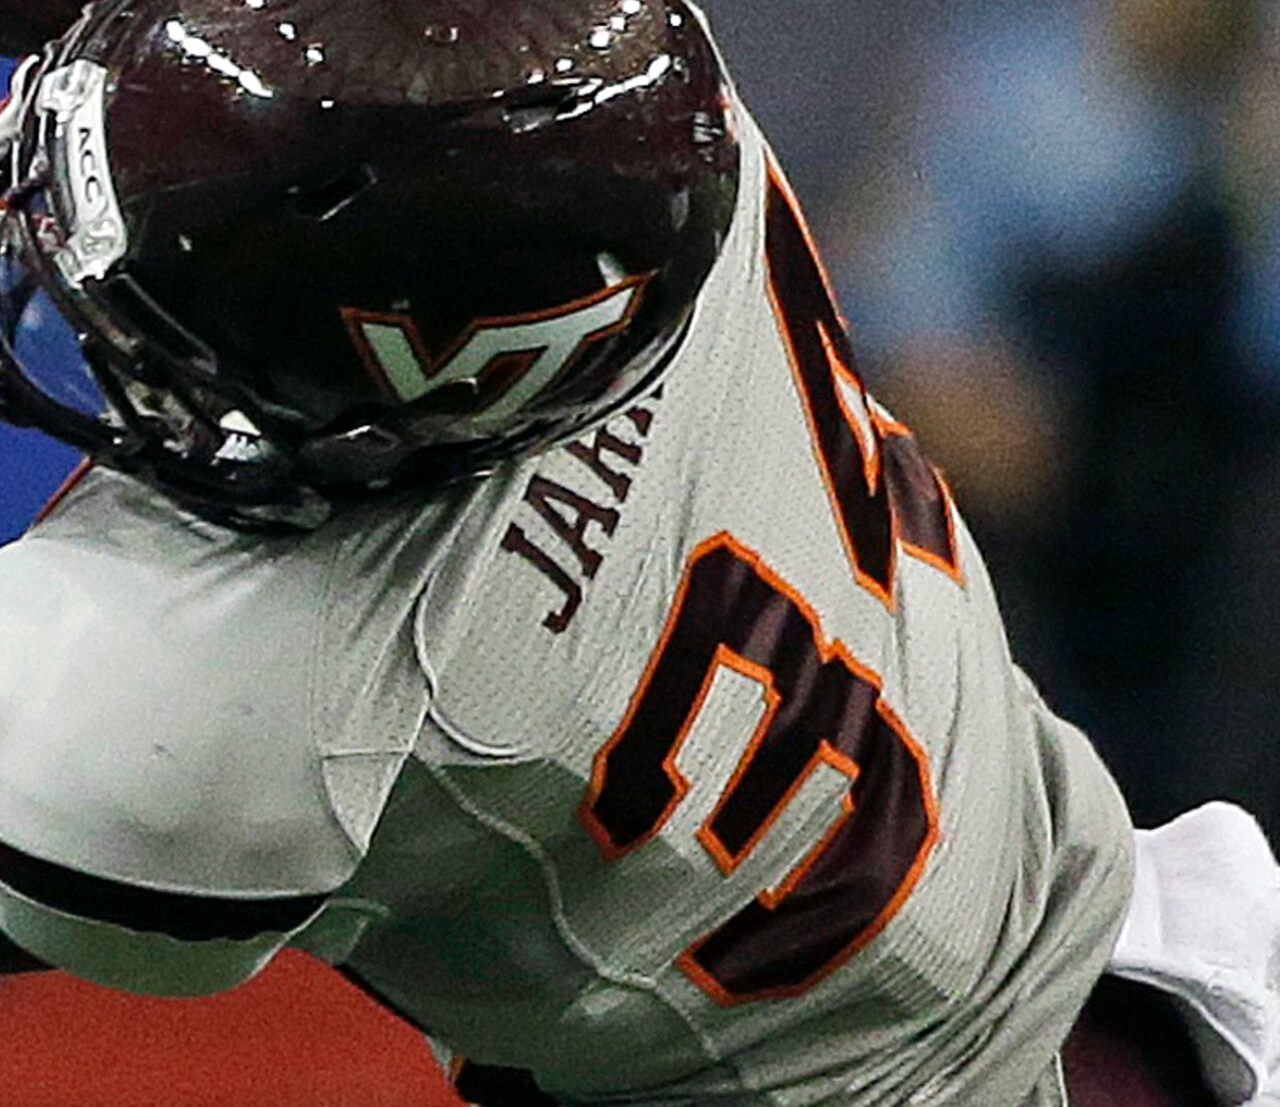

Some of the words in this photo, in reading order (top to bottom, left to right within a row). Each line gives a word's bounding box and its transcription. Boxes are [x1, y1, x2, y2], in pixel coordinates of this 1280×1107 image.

[78, 126, 103, 205] ACC
[338, 270, 662, 436] VT
[500, 382, 665, 636] JAR
[577, 144, 967, 1008] 34
